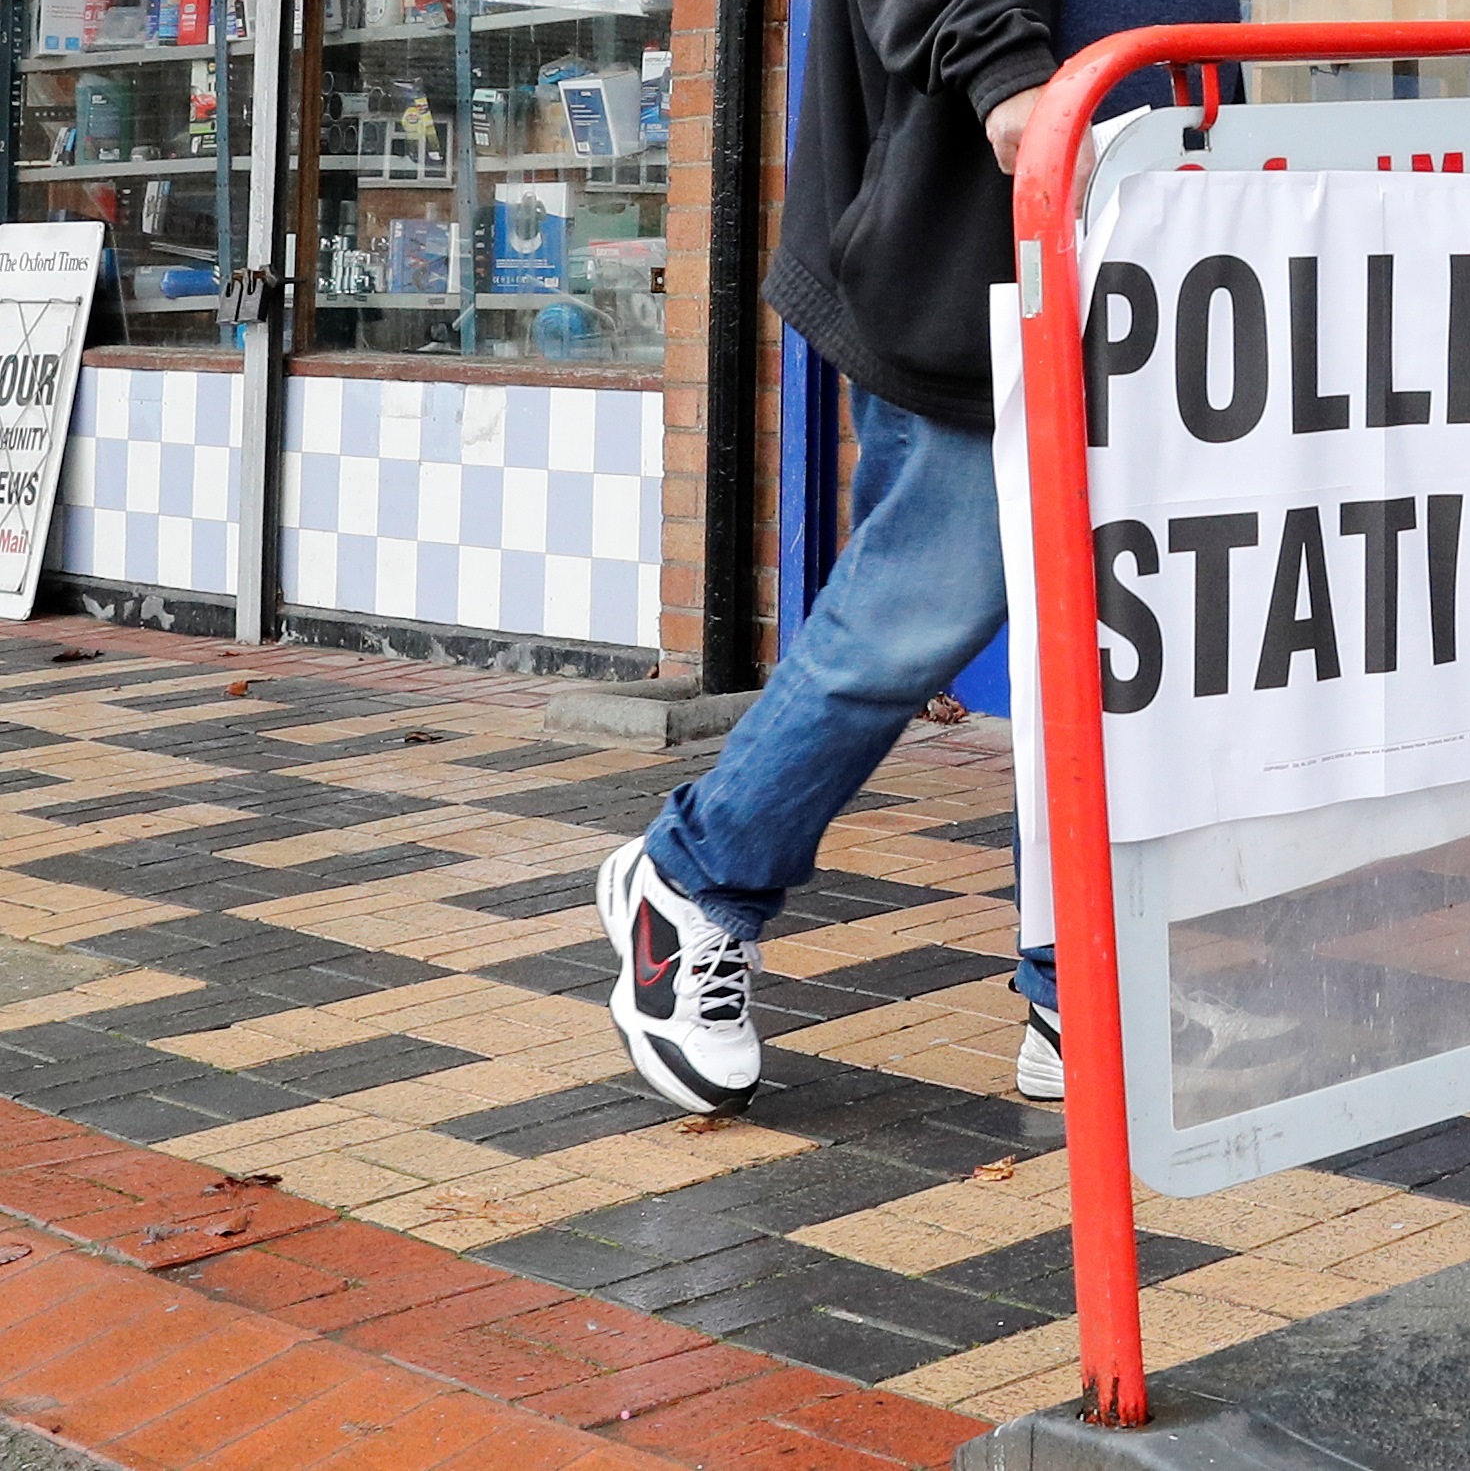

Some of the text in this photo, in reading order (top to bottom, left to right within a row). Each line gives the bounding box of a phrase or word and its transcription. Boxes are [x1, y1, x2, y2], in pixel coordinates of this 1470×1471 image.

[0, 251, 89, 271] The Oxford Times
[0, 354, 59, 406] OUR
